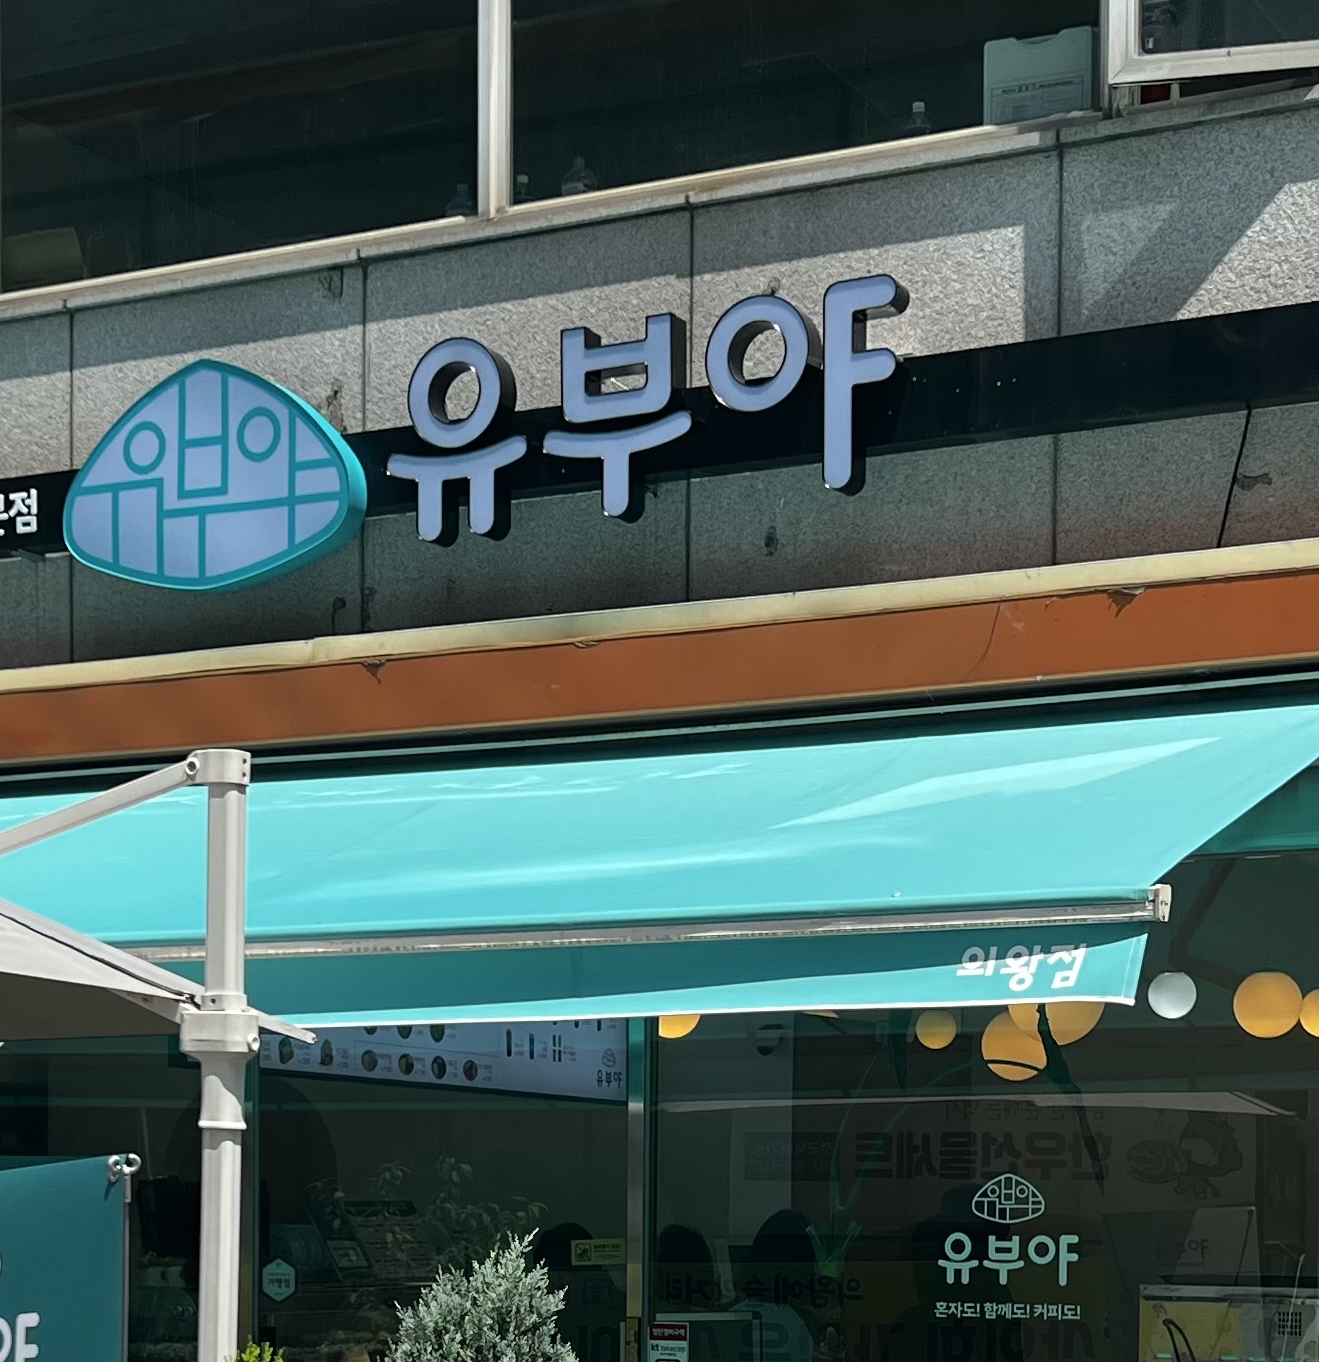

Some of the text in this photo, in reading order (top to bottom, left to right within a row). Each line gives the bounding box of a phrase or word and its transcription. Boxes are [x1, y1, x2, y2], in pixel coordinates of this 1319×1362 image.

[386, 273, 903, 545] 유부야
[956, 943, 1087, 992] 의왕점
[937, 1231, 1080, 1287] 유부야
[933, 1301, 1081, 1320] 혼자도! 함께도! 커피도!
